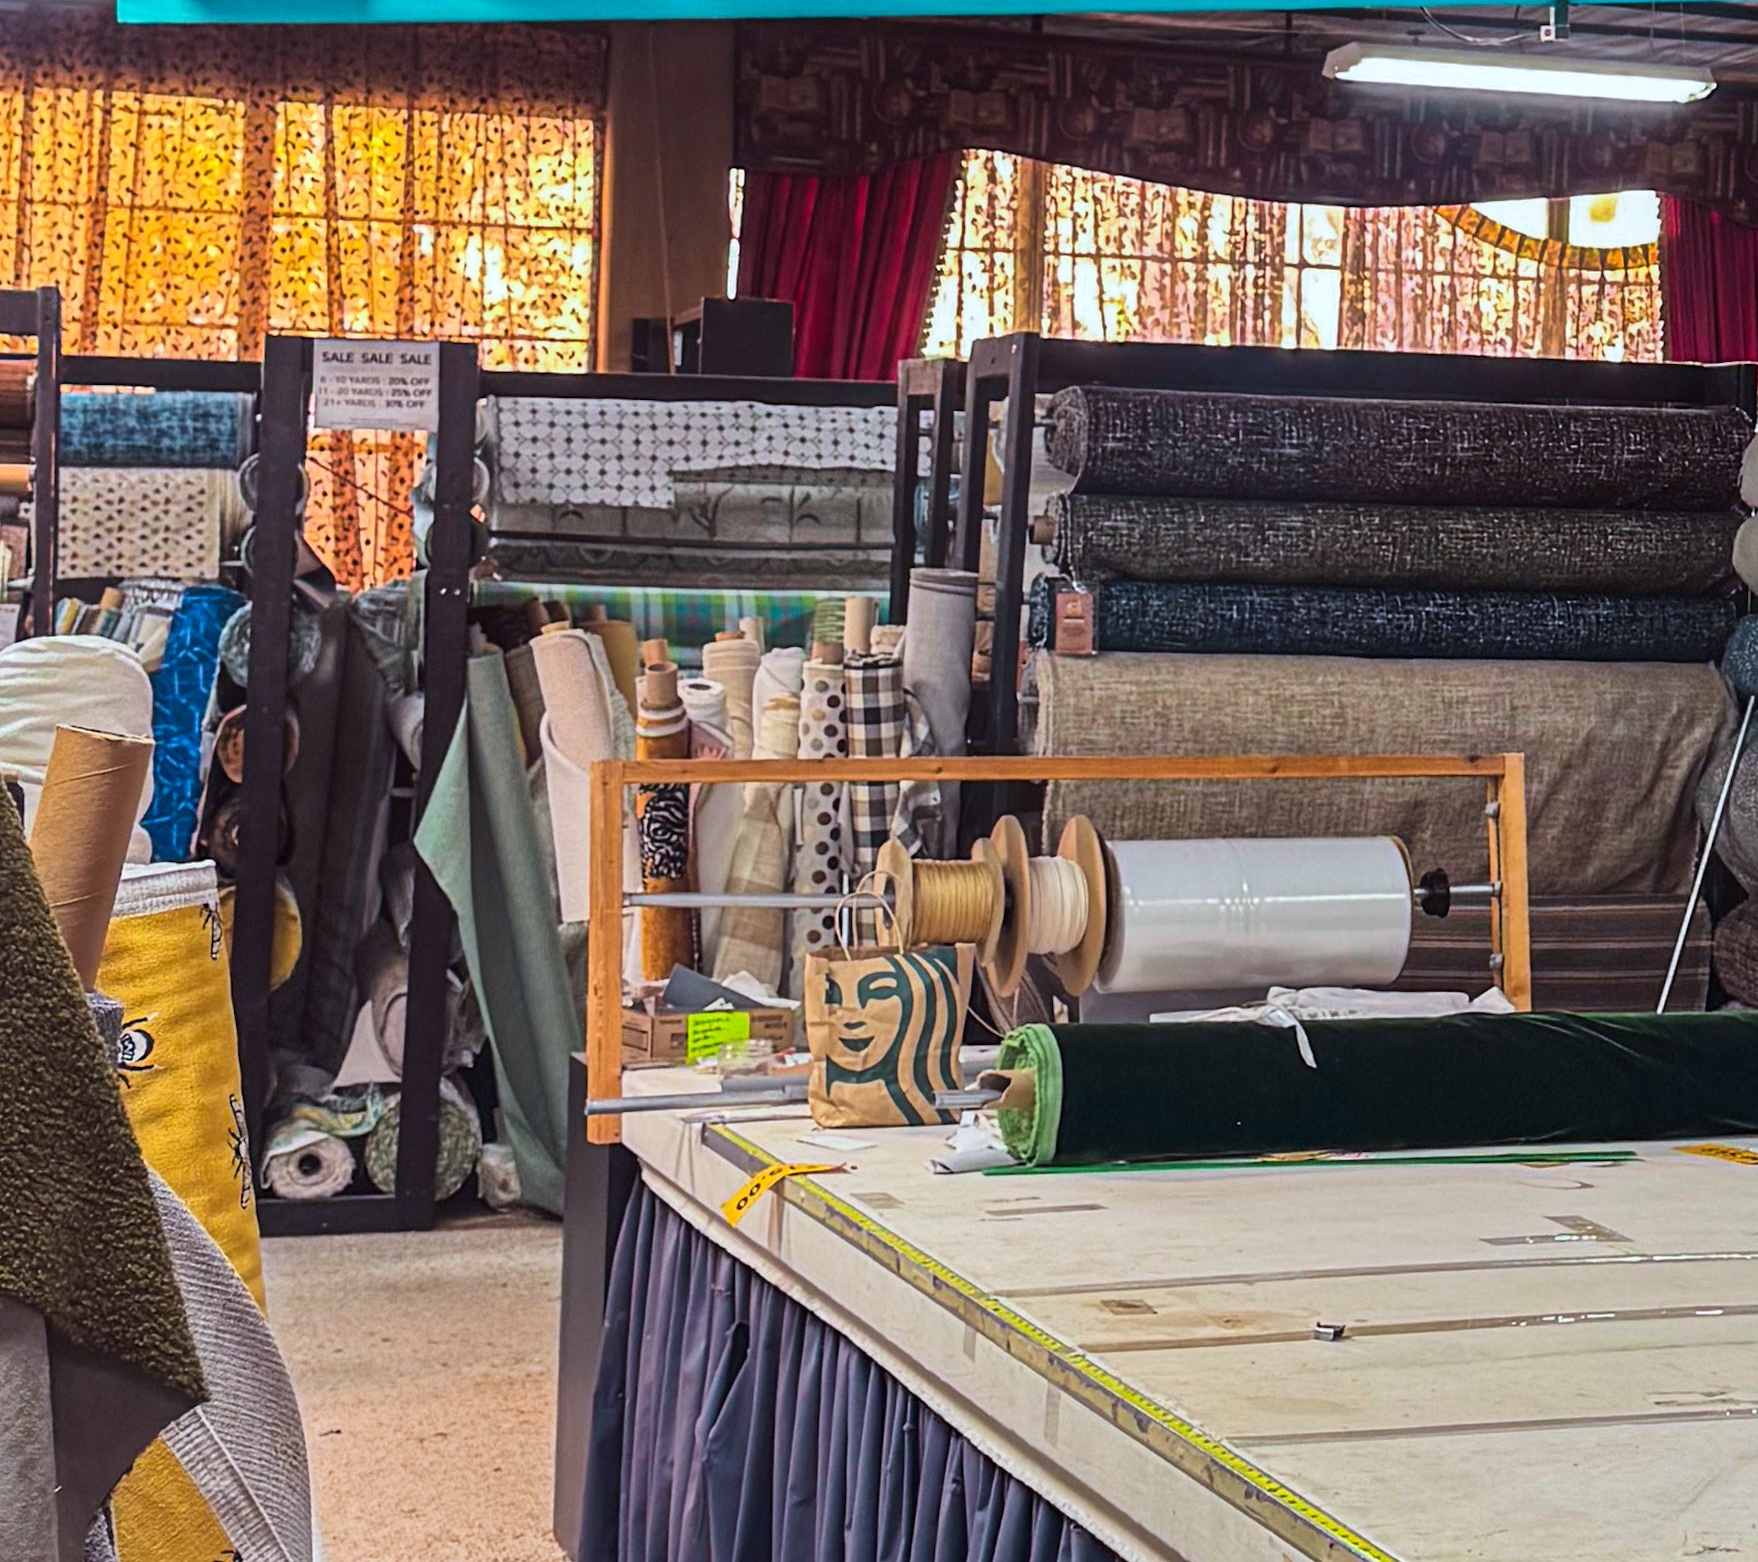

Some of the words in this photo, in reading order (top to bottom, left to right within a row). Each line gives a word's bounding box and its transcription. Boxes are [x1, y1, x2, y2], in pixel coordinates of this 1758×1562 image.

[322, 351, 354, 363] SALE
[361, 353, 393, 365] SALE
[400, 353, 432, 365] SALE
[410, 378, 430, 386] OFF
[413, 388, 432, 397] OFF
[406, 400, 426, 408] OFF
